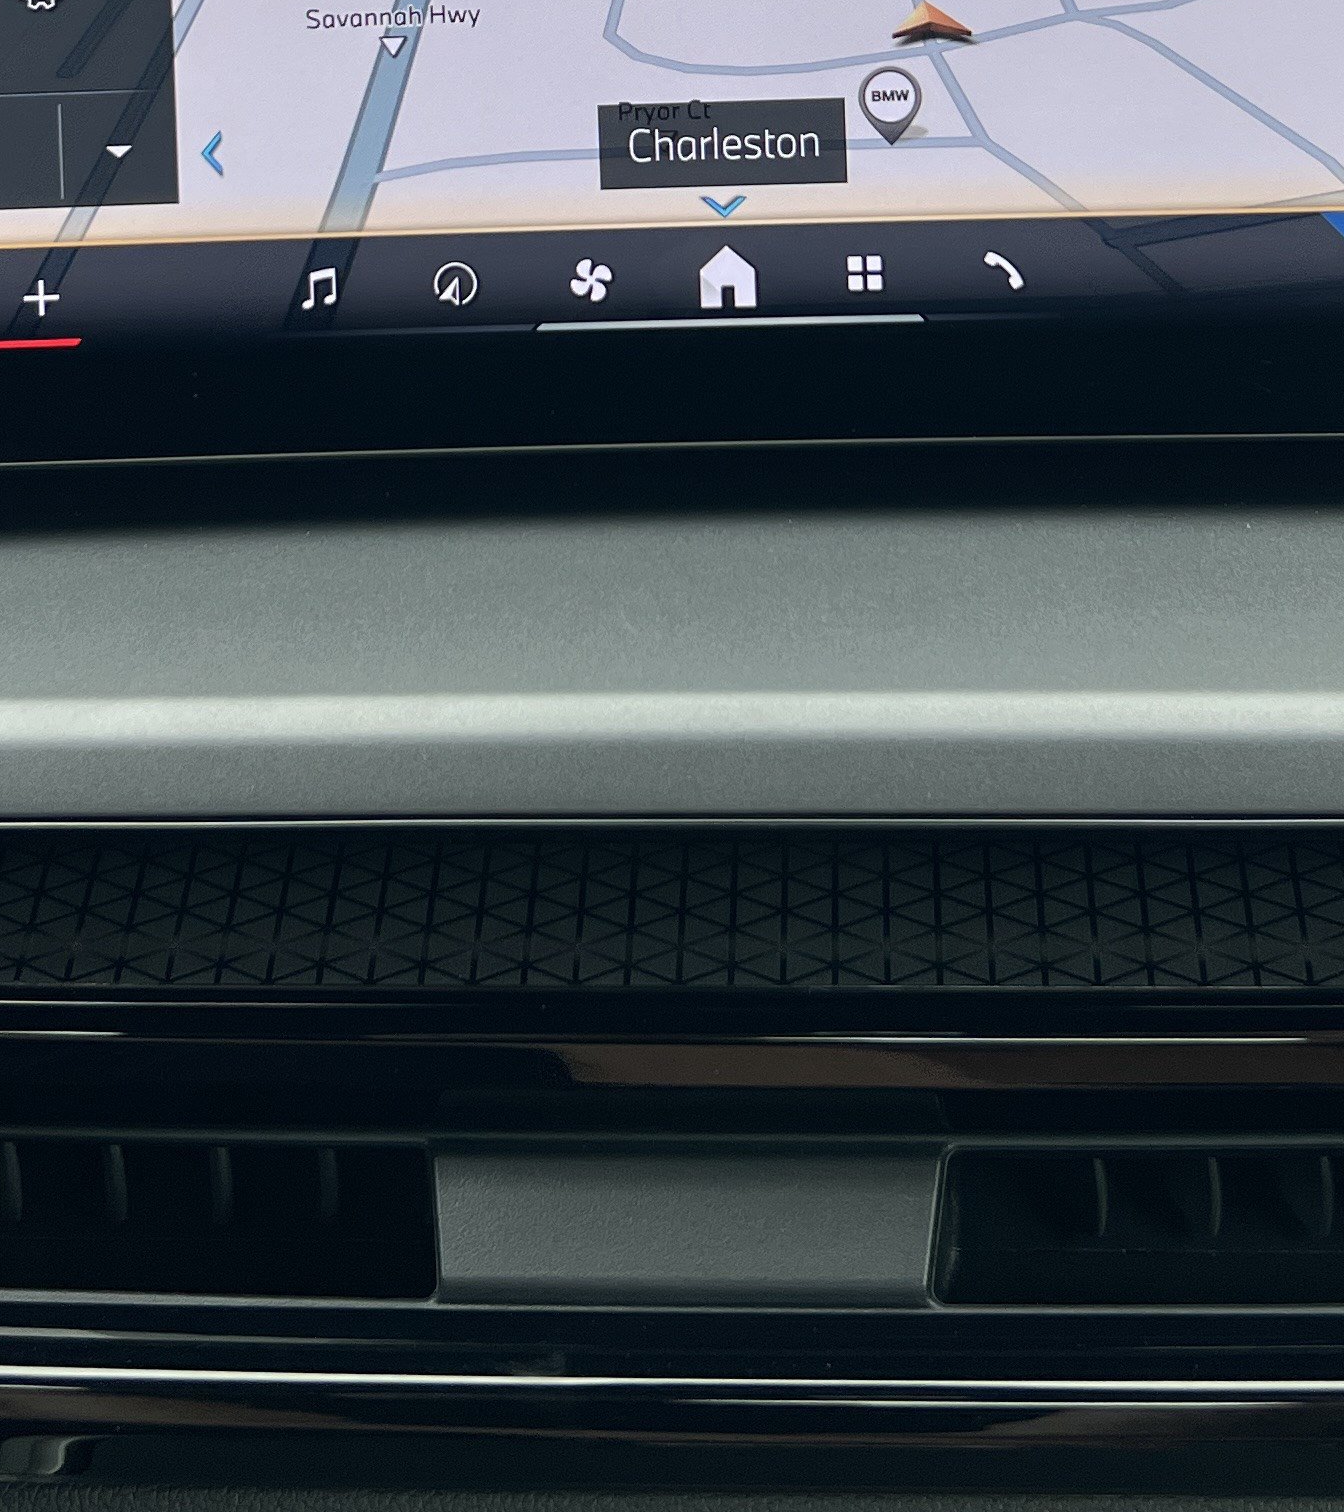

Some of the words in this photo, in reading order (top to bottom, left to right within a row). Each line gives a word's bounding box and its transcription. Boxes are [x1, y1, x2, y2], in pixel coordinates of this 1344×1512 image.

[306, 6, 422, 29] Savannah
[430, 4, 480, 28] Hwy
[871, 90, 909, 102] BMW
[618, 101, 680, 125] Pryor
[687, 99, 711, 120] Ct
[628, 127, 820, 163] Charleston
